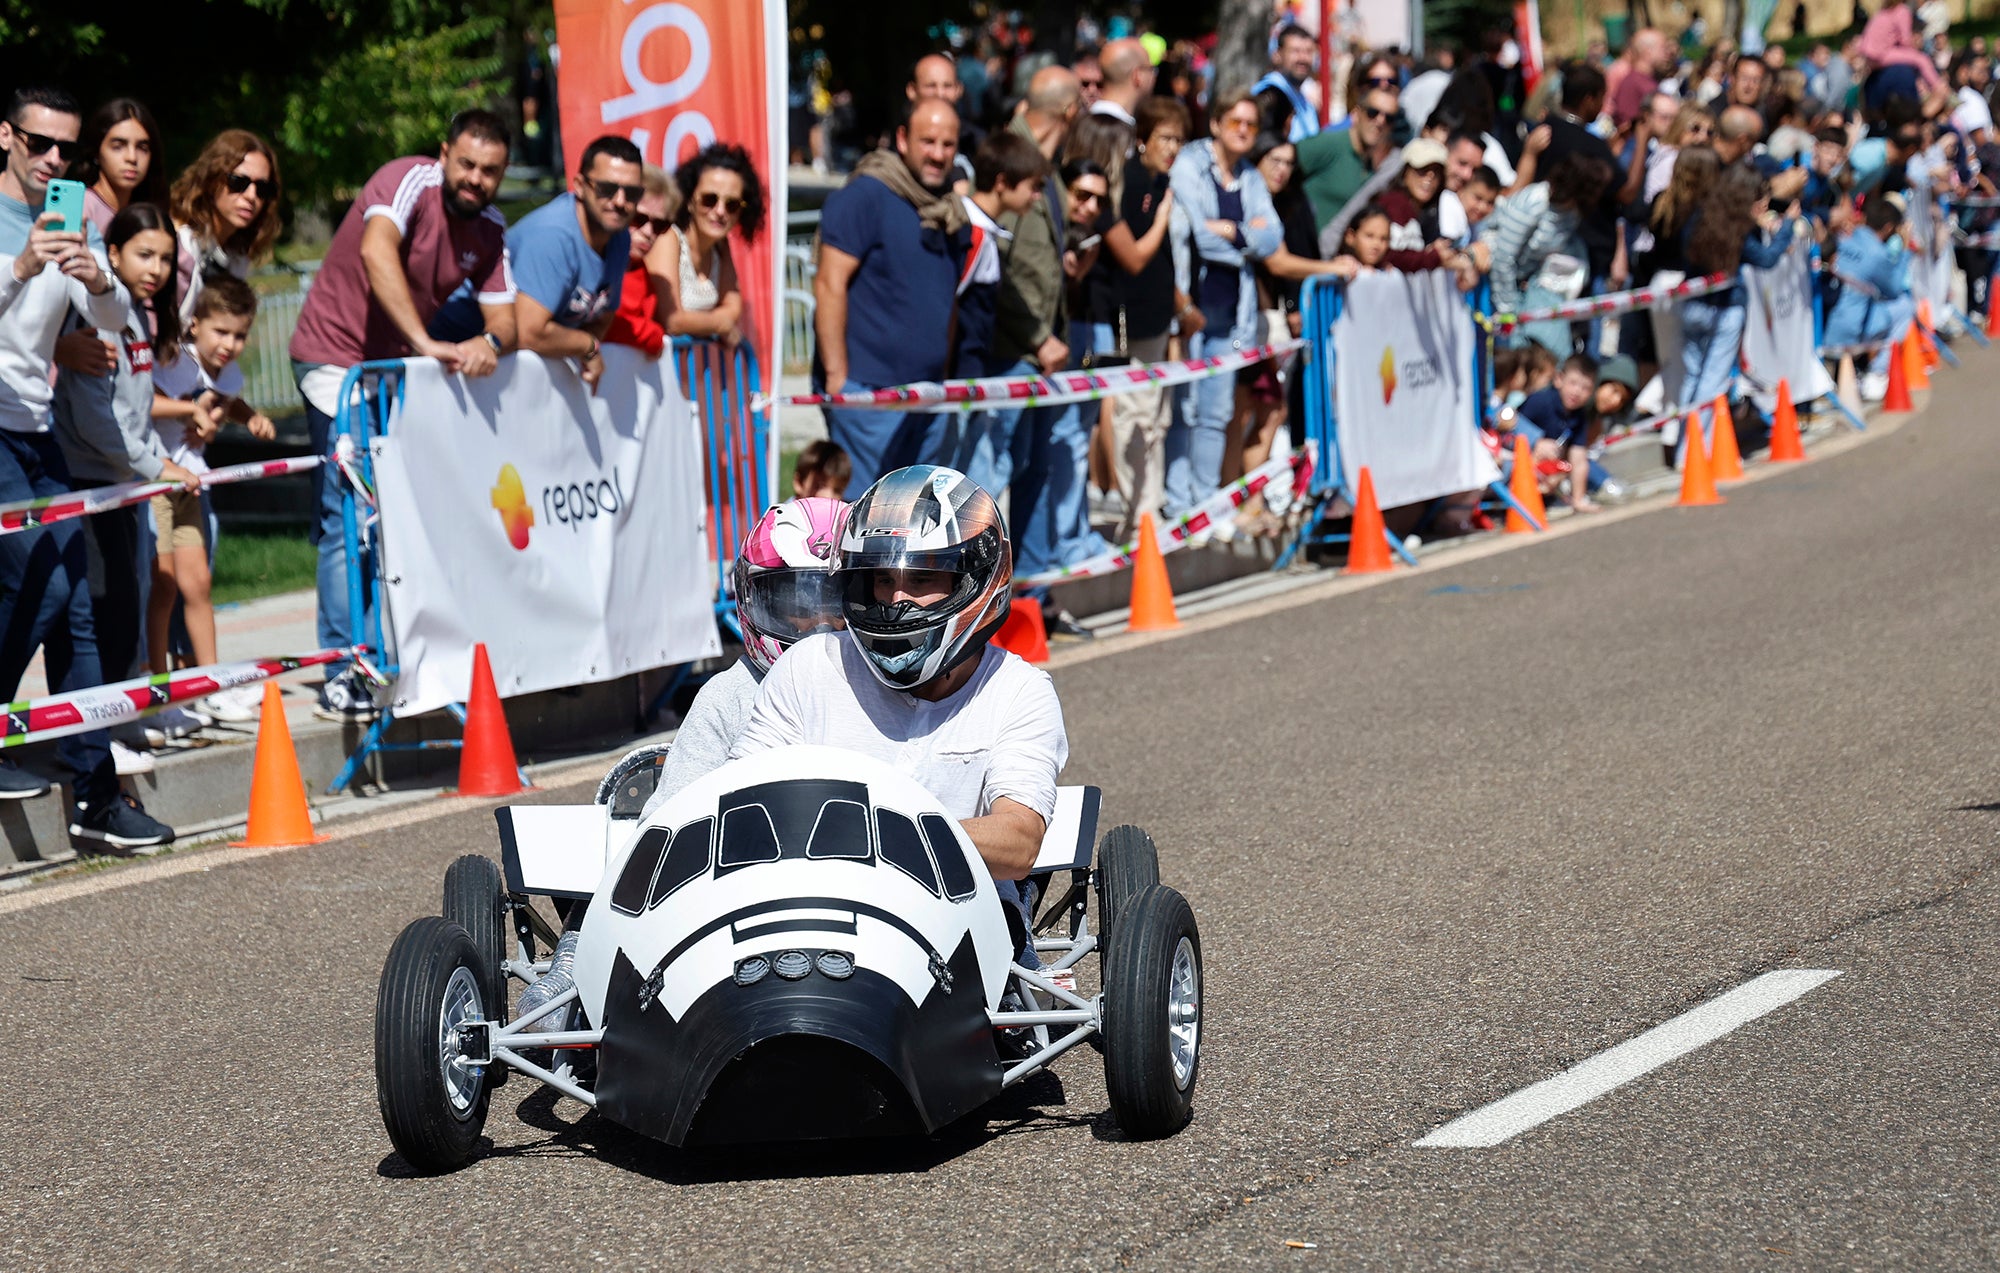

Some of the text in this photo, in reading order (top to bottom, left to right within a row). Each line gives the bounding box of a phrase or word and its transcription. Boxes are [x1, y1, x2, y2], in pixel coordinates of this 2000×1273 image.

[542, 464, 625, 533] repsol
[860, 527, 912, 538] LS2
[85, 700, 130, 721] LABORAL
